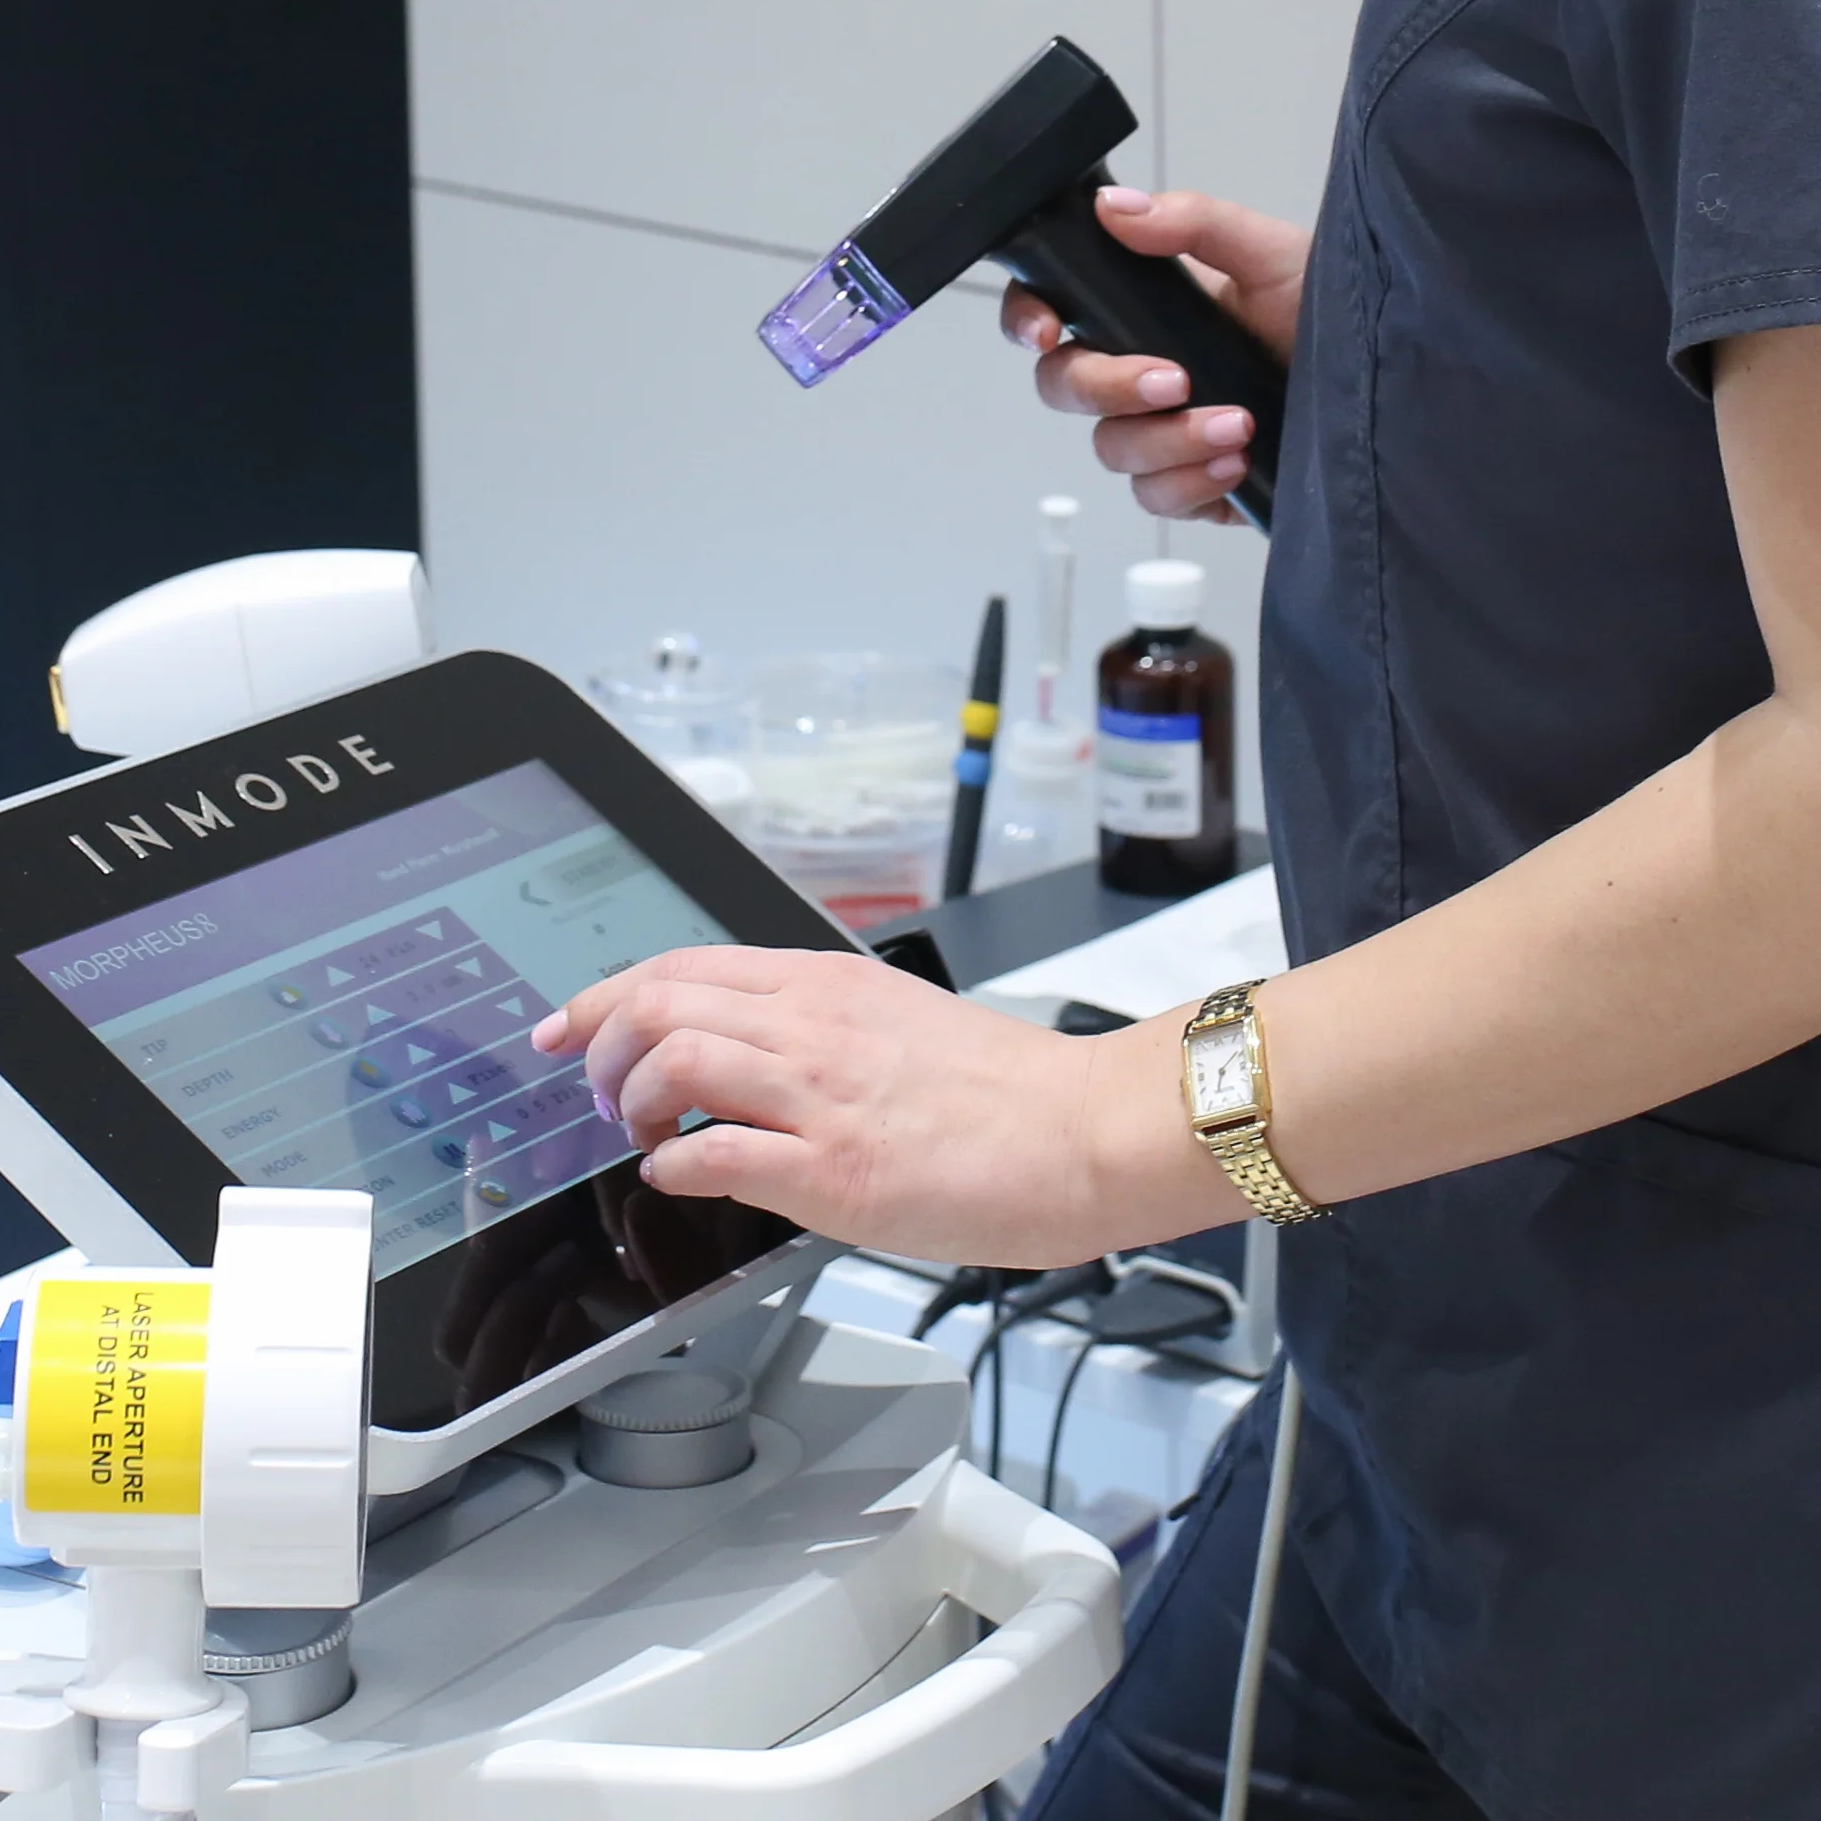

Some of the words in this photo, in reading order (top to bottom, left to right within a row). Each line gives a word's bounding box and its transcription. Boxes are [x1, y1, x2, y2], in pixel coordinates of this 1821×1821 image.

[68, 734, 395, 874] INMODE
[49, 912, 218, 990] MORPHEUS8
[141, 1038, 168, 1057] TIP
[181, 1069, 234, 1097] DEPTH
[220, 1106, 282, 1140] ENERGY
[260, 1150, 308, 1178] MODE
[414, 1201, 461, 1228] RESET
[100, 1305, 120, 1328] AT
[128, 1292, 154, 1359] LASER
[92, 1336, 118, 1424] DISTAL
[122, 1367, 147, 1503] APERTURE
[91, 1433, 113, 1485] END
